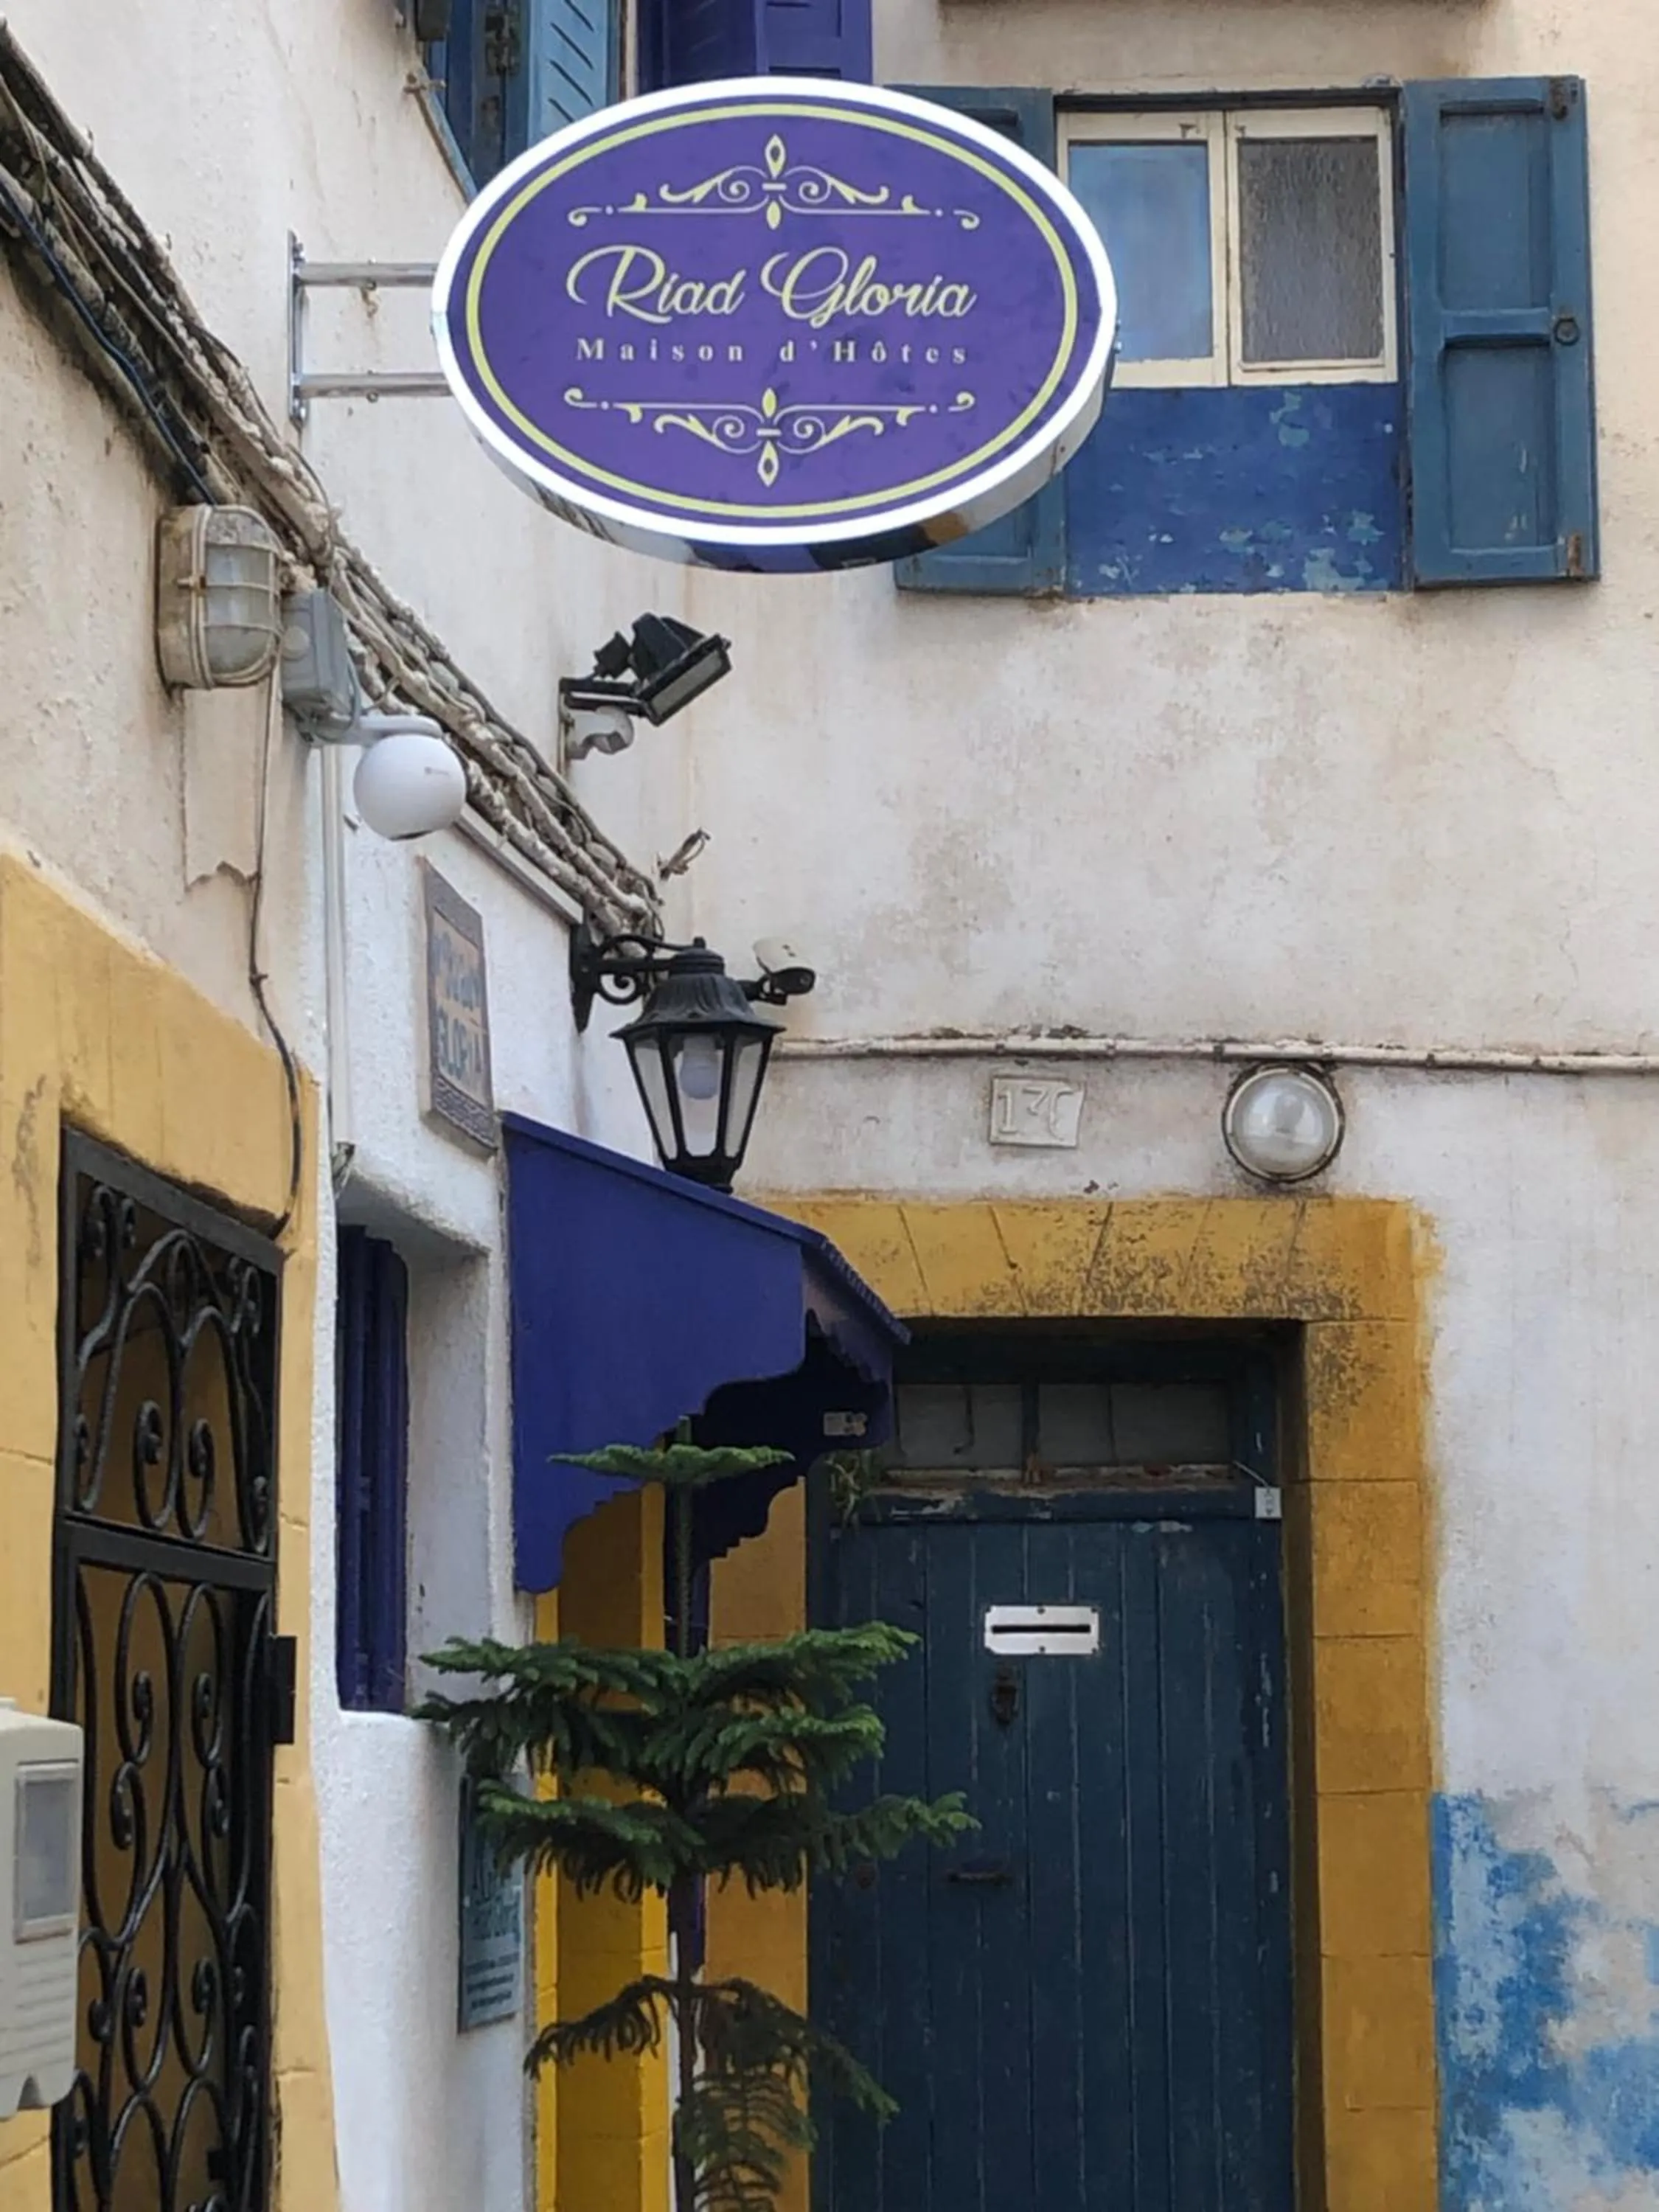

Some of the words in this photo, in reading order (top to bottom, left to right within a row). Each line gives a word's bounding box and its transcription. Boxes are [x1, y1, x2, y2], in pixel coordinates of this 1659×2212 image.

[565, 244, 747, 324] Riad
[759, 246, 978, 330] Gloria
[577, 338, 743, 362] Maison
[779, 339, 966, 364] d'Hôtes
